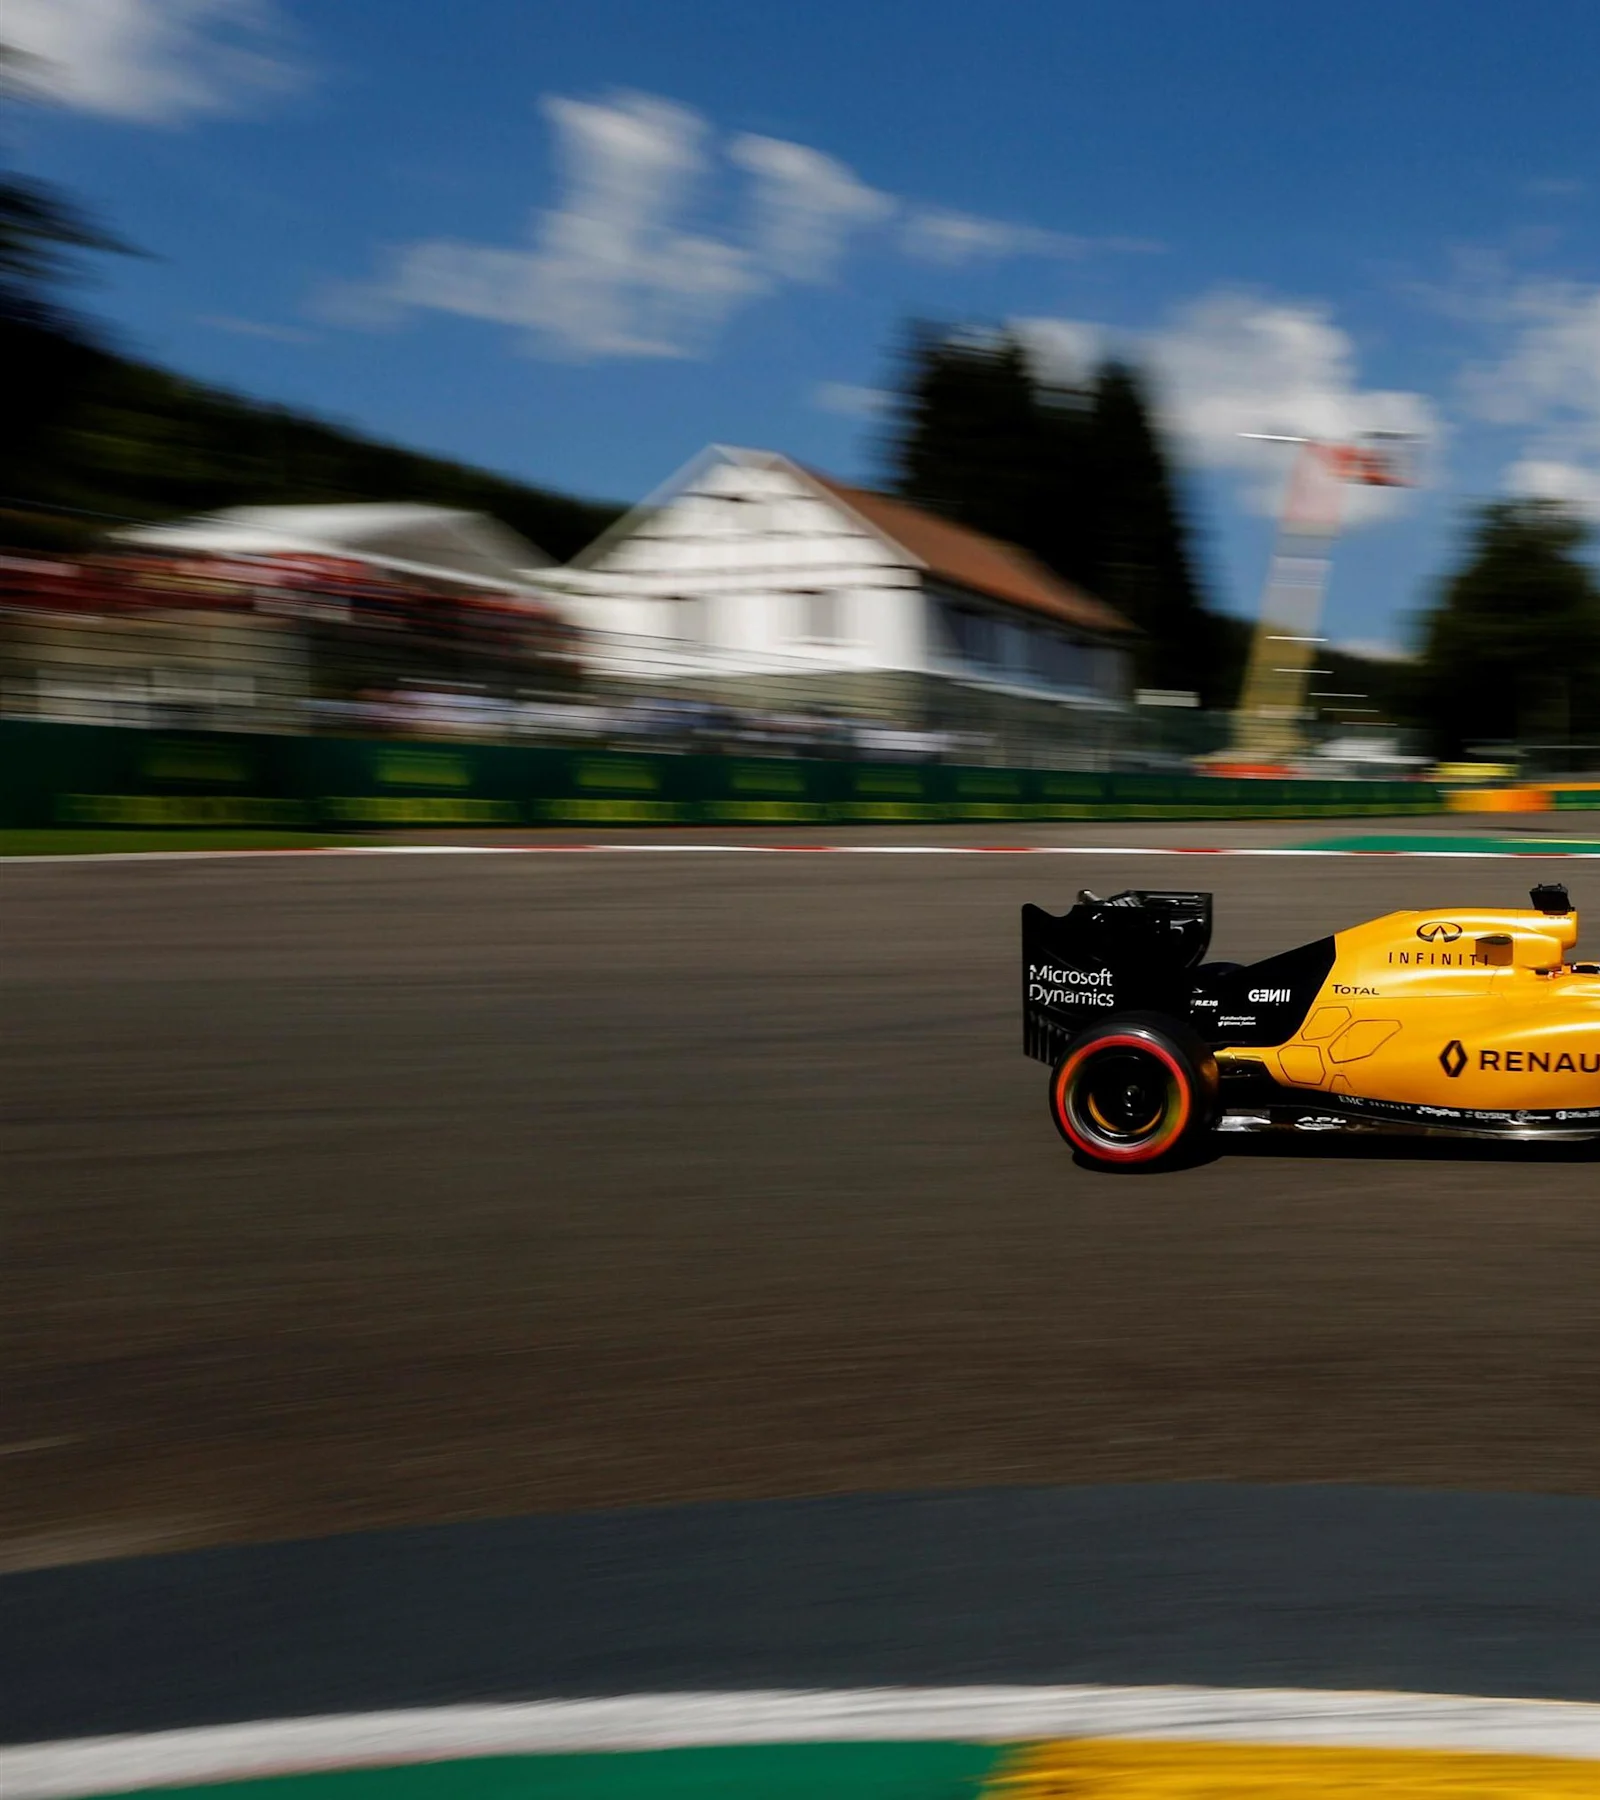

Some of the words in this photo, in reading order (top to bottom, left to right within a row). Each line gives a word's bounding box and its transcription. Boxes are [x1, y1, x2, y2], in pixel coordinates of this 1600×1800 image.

[1388, 951, 1490, 966] INFINITI
[1029, 964, 1114, 987] Microsoft
[1029, 984, 1115, 1007] Dynamics
[1332, 984, 1380, 996] TOTAL
